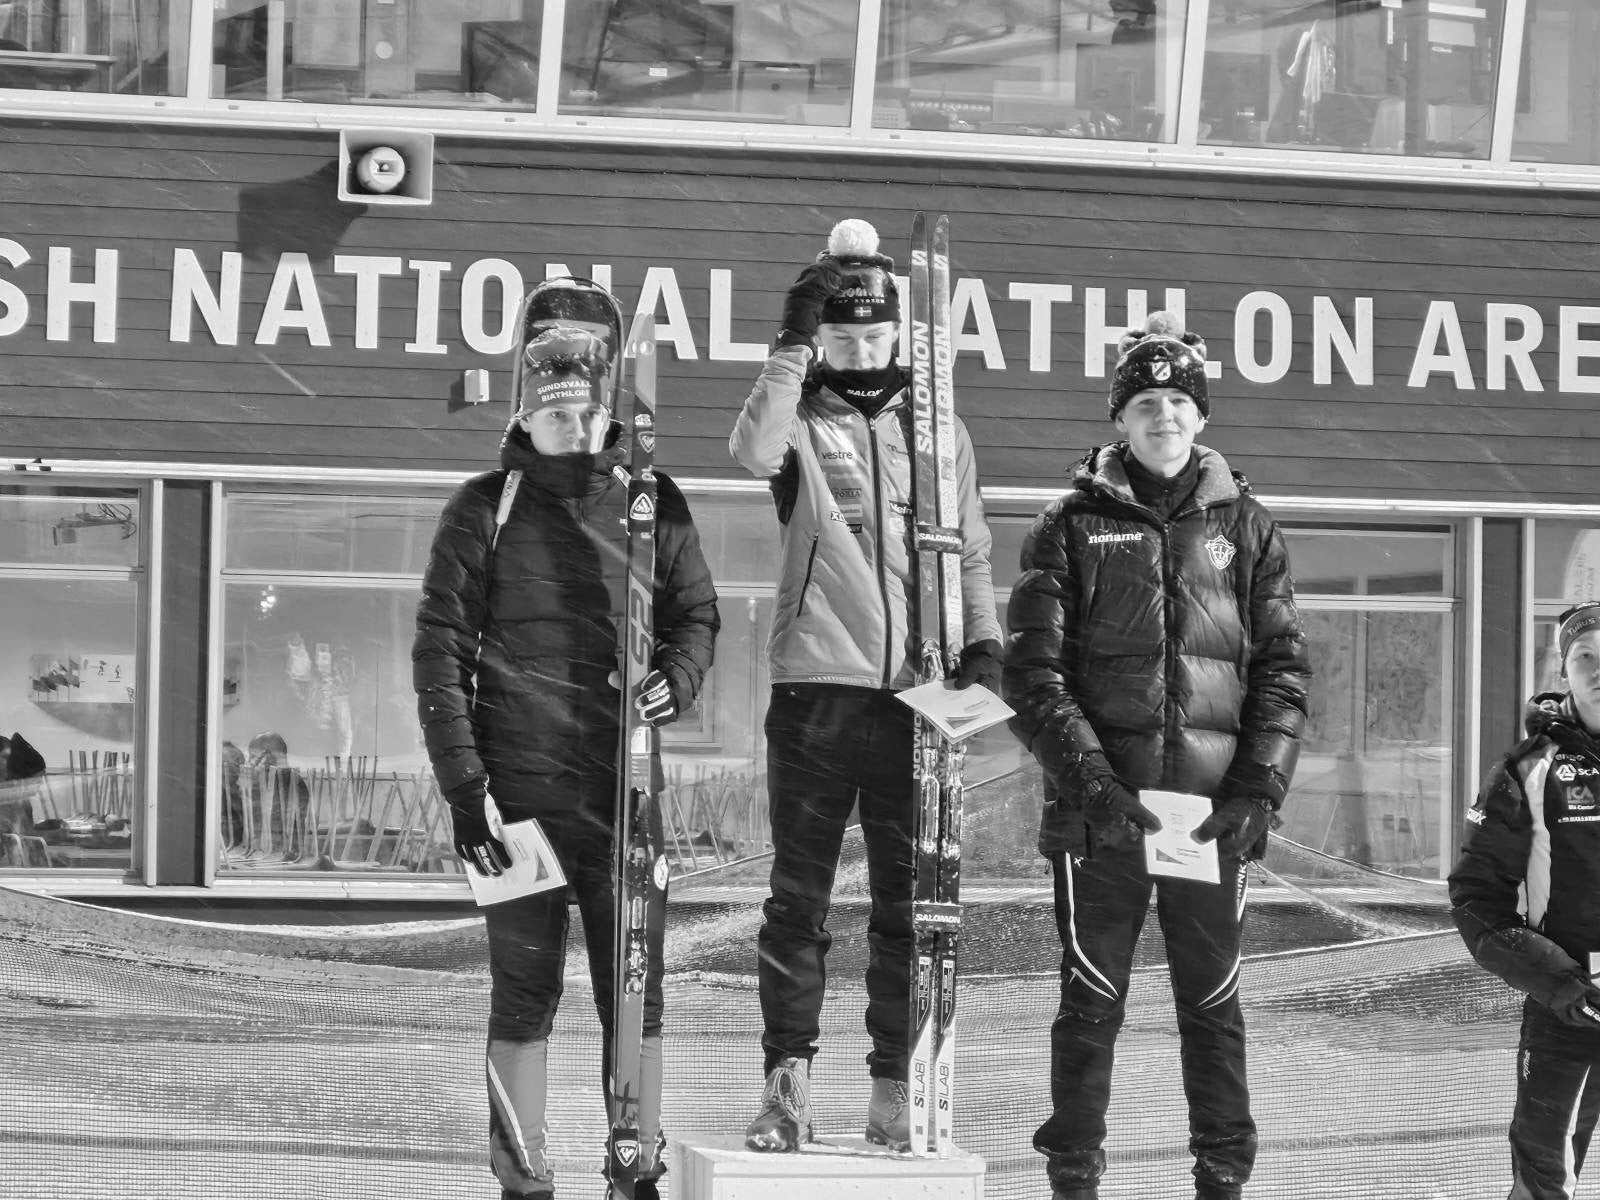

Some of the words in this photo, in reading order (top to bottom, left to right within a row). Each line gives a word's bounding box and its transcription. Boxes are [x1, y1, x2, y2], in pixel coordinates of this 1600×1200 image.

[170, 248, 769, 362] NATIOAL
[1407, 300, 1600, 394] ARE
[536, 380, 593, 395] SUNDSVALL
[912, 320, 934, 455] SALOMON
[541, 389, 590, 402] BIATHLON
[918, 532, 963, 545] SALOMON
[1087, 531, 1144, 544] noname
[1578, 767, 1600, 776] SCA
[915, 912, 961, 924] SALOMON
